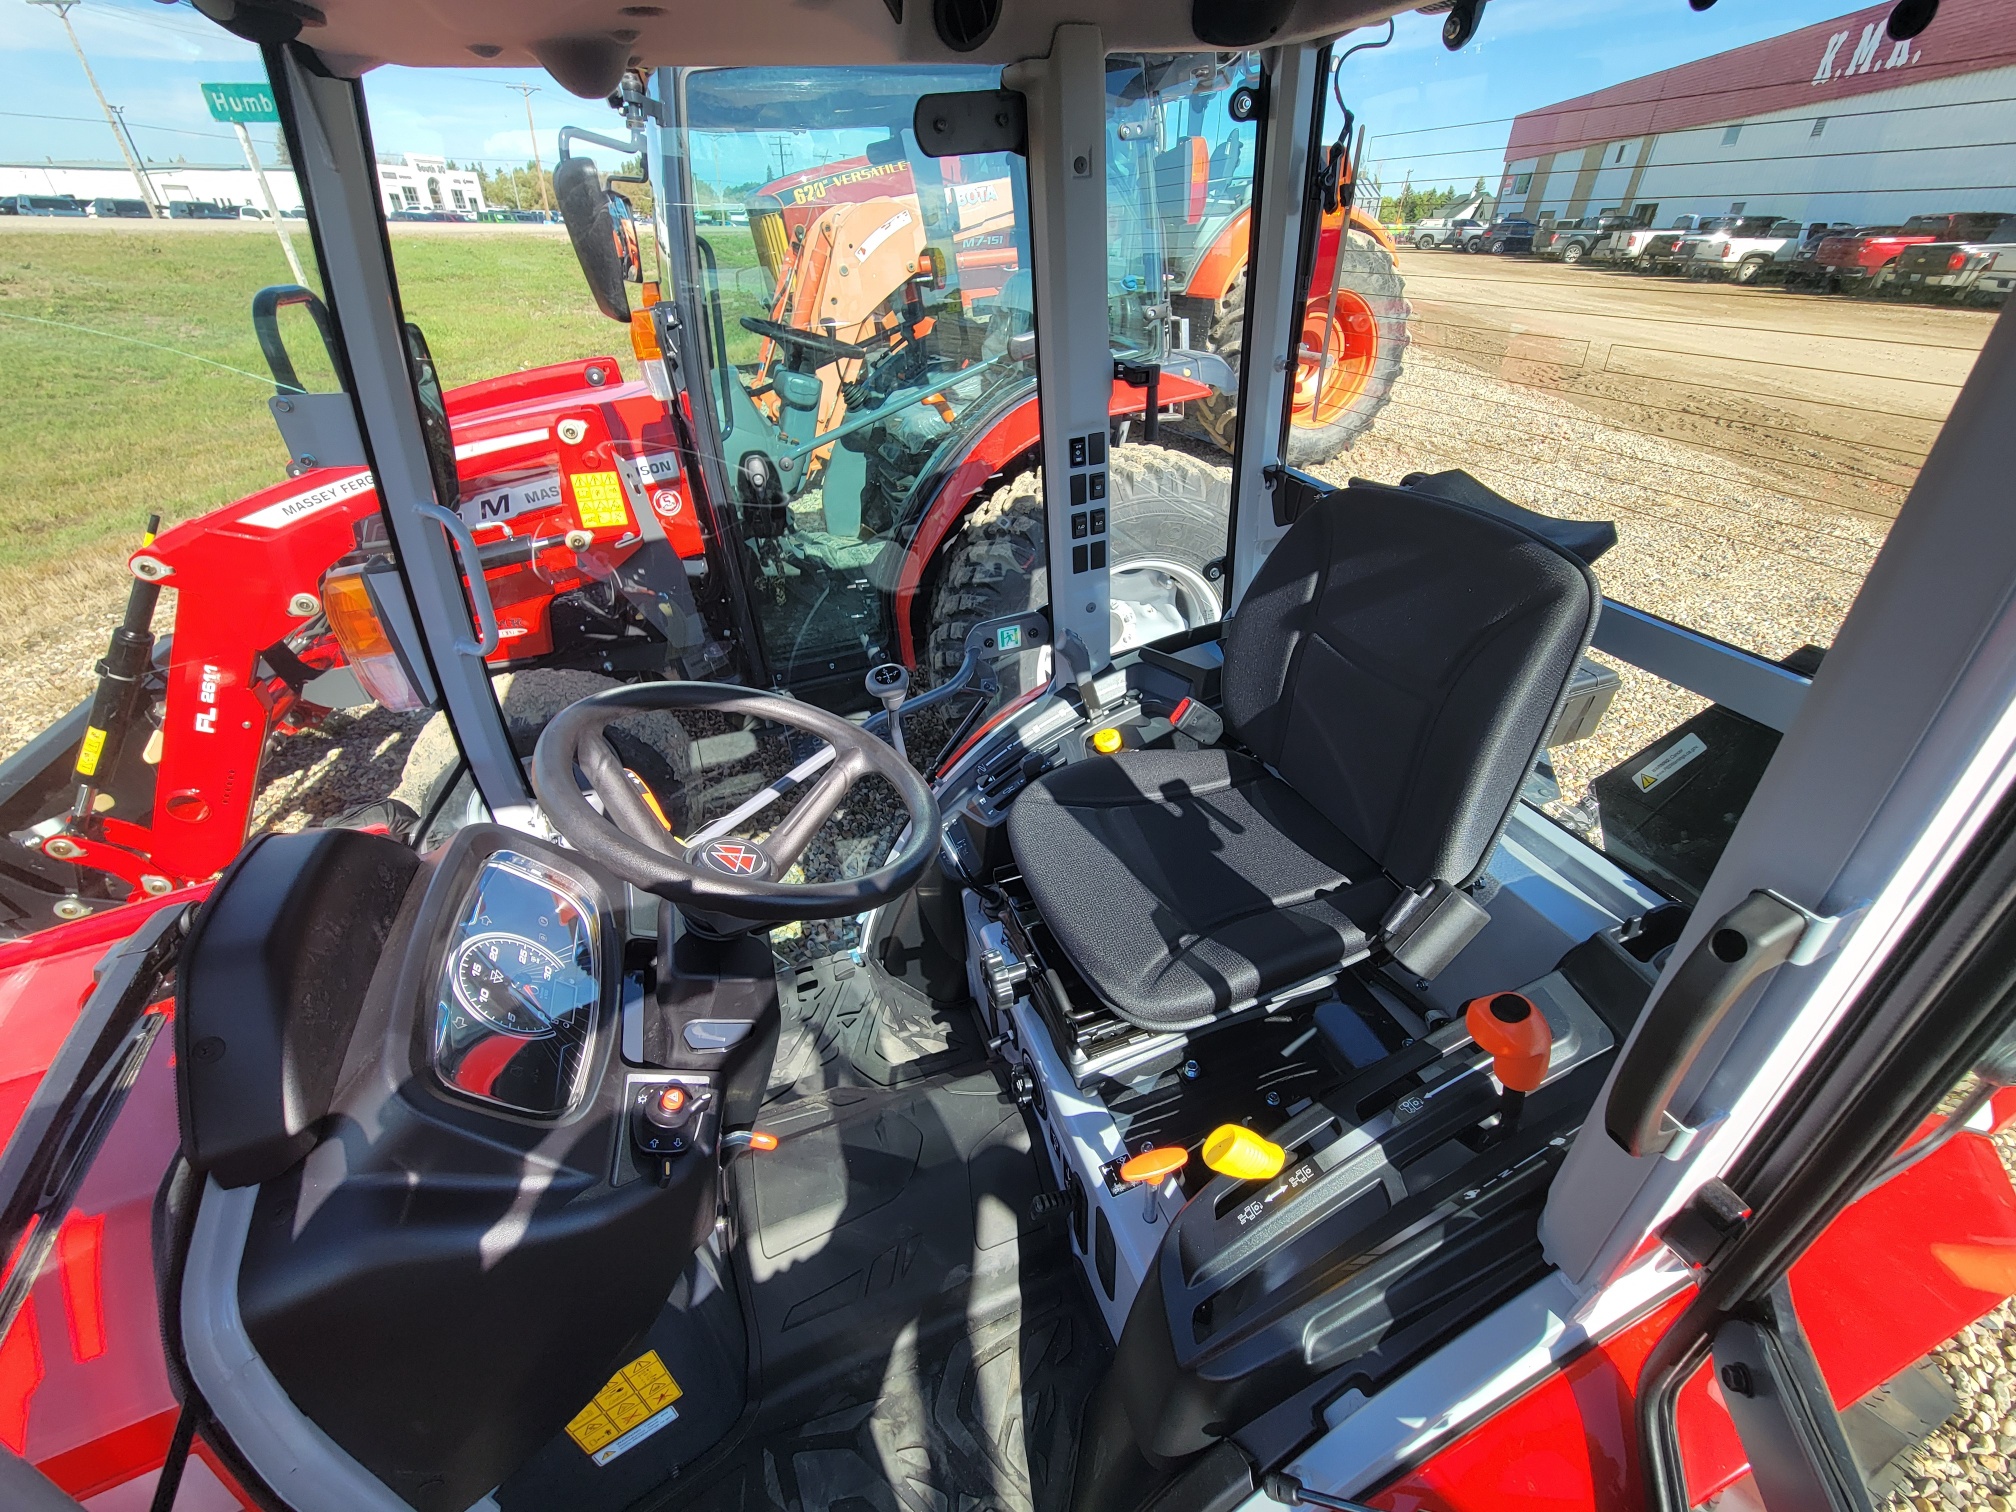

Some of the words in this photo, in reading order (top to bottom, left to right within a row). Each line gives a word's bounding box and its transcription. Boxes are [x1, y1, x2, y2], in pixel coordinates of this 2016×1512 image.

[212, 92, 273, 112] Humb
[793, 181, 827, 205] 620
[833, 160, 908, 187] VERSATILE
[963, 235, 1004, 248] M7-151
[282, 488, 337, 516] MASSEY
[200, 664, 220, 704] 2611
[195, 707, 217, 734] FL
[489, 946, 499, 962] 20
[519, 948, 528, 964] 25
[471, 962, 482, 977] 15
[543, 965, 553, 981] 30
[479, 988, 489, 1003] 10
[507, 1012, 516, 1022] 5
